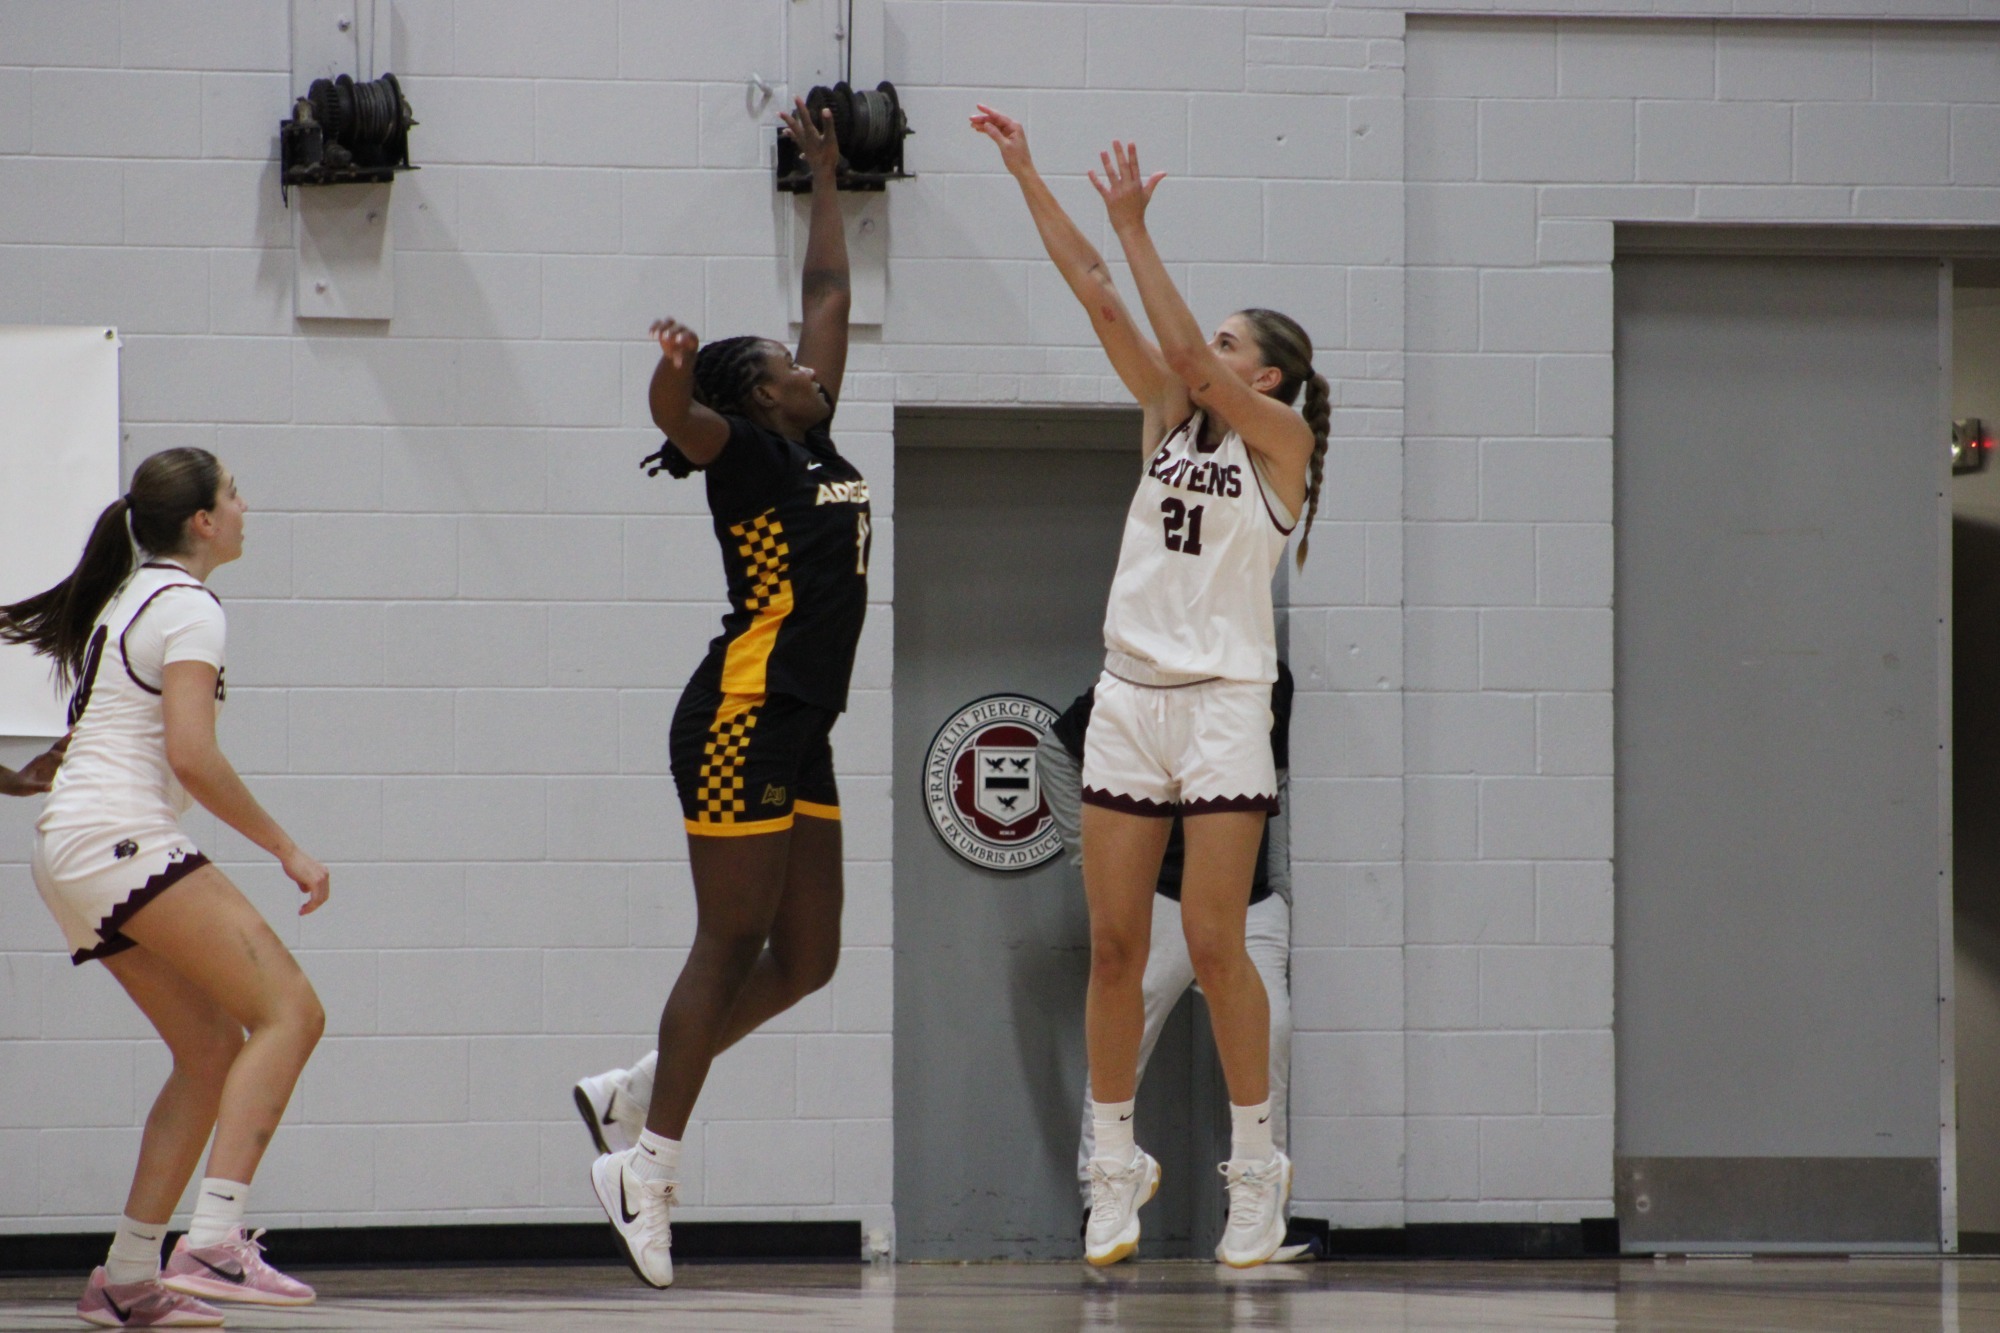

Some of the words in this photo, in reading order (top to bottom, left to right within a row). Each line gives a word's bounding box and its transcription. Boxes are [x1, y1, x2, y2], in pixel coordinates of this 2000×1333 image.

[1149, 448, 1241, 498] RAVENS
[1161, 497, 1204, 556] 21
[931, 717, 970, 802] FRANKLIN
[972, 702, 1030, 723] PIERCE
[1034, 709, 1053, 729] UN
[944, 822, 962, 840] EX
[959, 836, 1006, 864] UMBRIS
[1008, 851, 1028, 864] AD
[1029, 829, 1062, 859] LUCE
